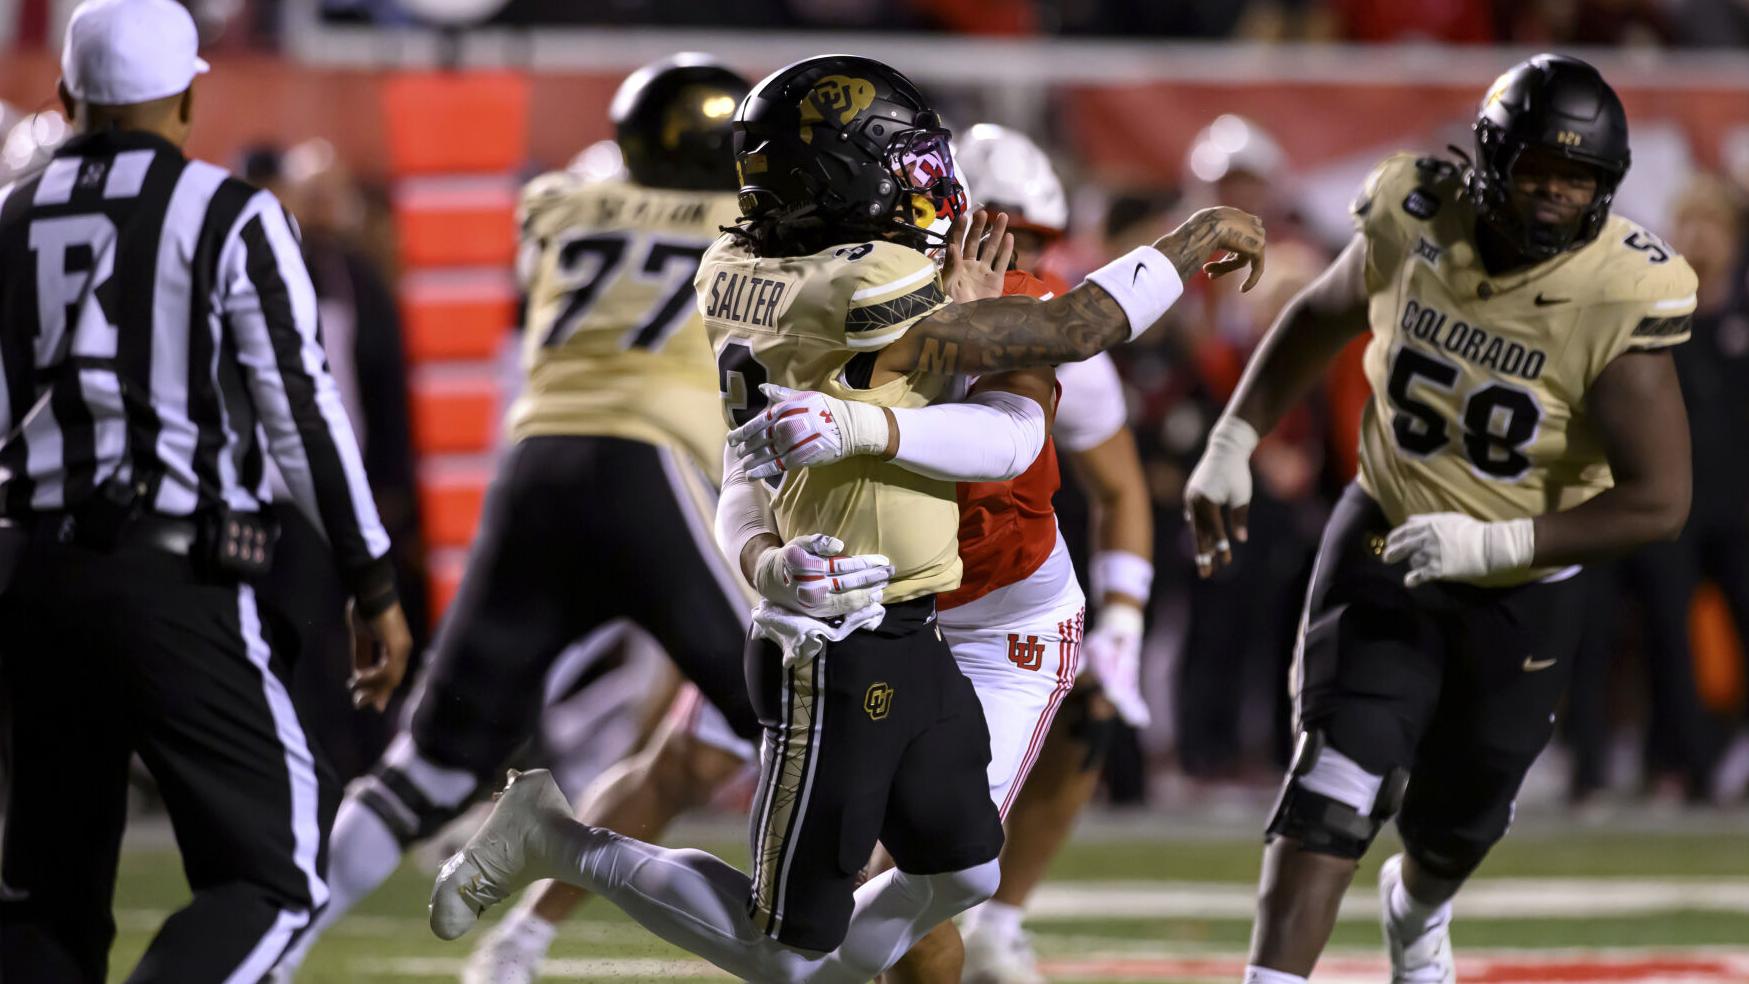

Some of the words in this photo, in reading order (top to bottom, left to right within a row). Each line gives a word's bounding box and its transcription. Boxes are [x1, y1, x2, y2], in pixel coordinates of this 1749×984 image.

[28, 213, 118, 369] R
[550, 230, 715, 352] 77
[706, 271, 786, 328] SALTER
[1400, 299, 1547, 381] COLORADO
[1388, 346, 1543, 481] 58
